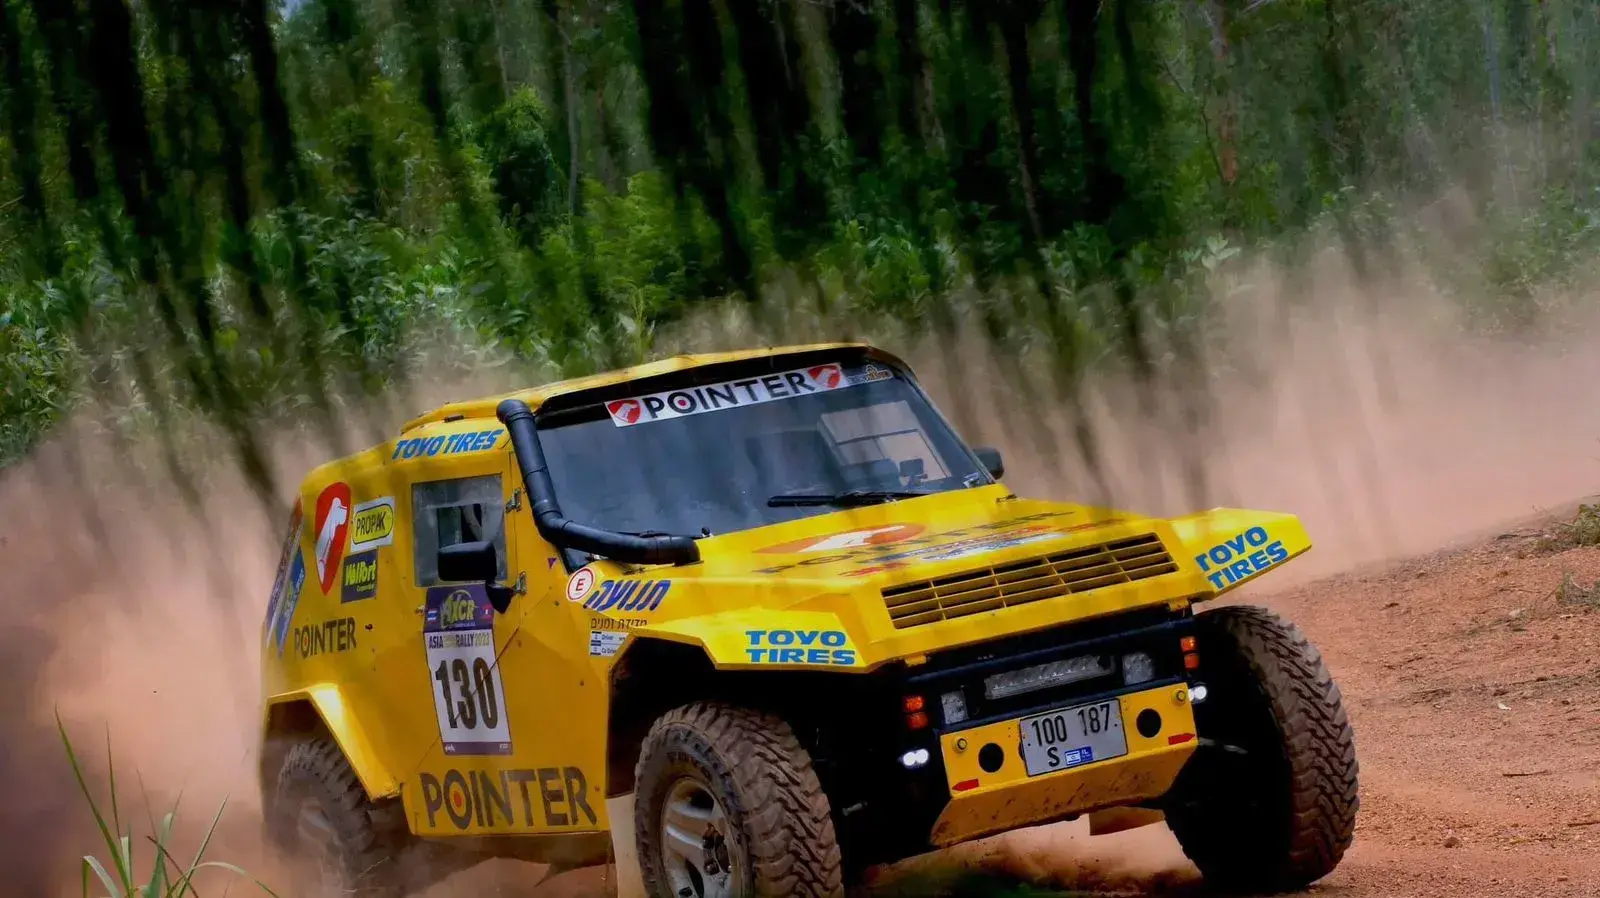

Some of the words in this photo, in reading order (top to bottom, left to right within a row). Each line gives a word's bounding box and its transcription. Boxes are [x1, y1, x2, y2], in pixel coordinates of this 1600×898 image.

[642, 371, 816, 420] POINTER
[392, 435, 446, 460] TOYO
[443, 429, 505, 454] TIRES
[356, 511, 387, 537] PROPAK
[1195, 526, 1268, 572] TOYO
[1208, 540, 1289, 589] TIRES
[575, 577, 586, 592] E
[583, 579, 672, 612] תנועה
[294, 616, 357, 660] POINTER
[429, 635, 444, 649] ASIA
[745, 630, 846, 646] TOYO
[745, 648, 855, 665] TIRES
[435, 656, 499, 730] 130
[1031, 714, 1068, 747] 100
[1077, 703, 1110, 737] 187
[1046, 746, 1060, 768] S
[419, 766, 598, 831] POINTER
